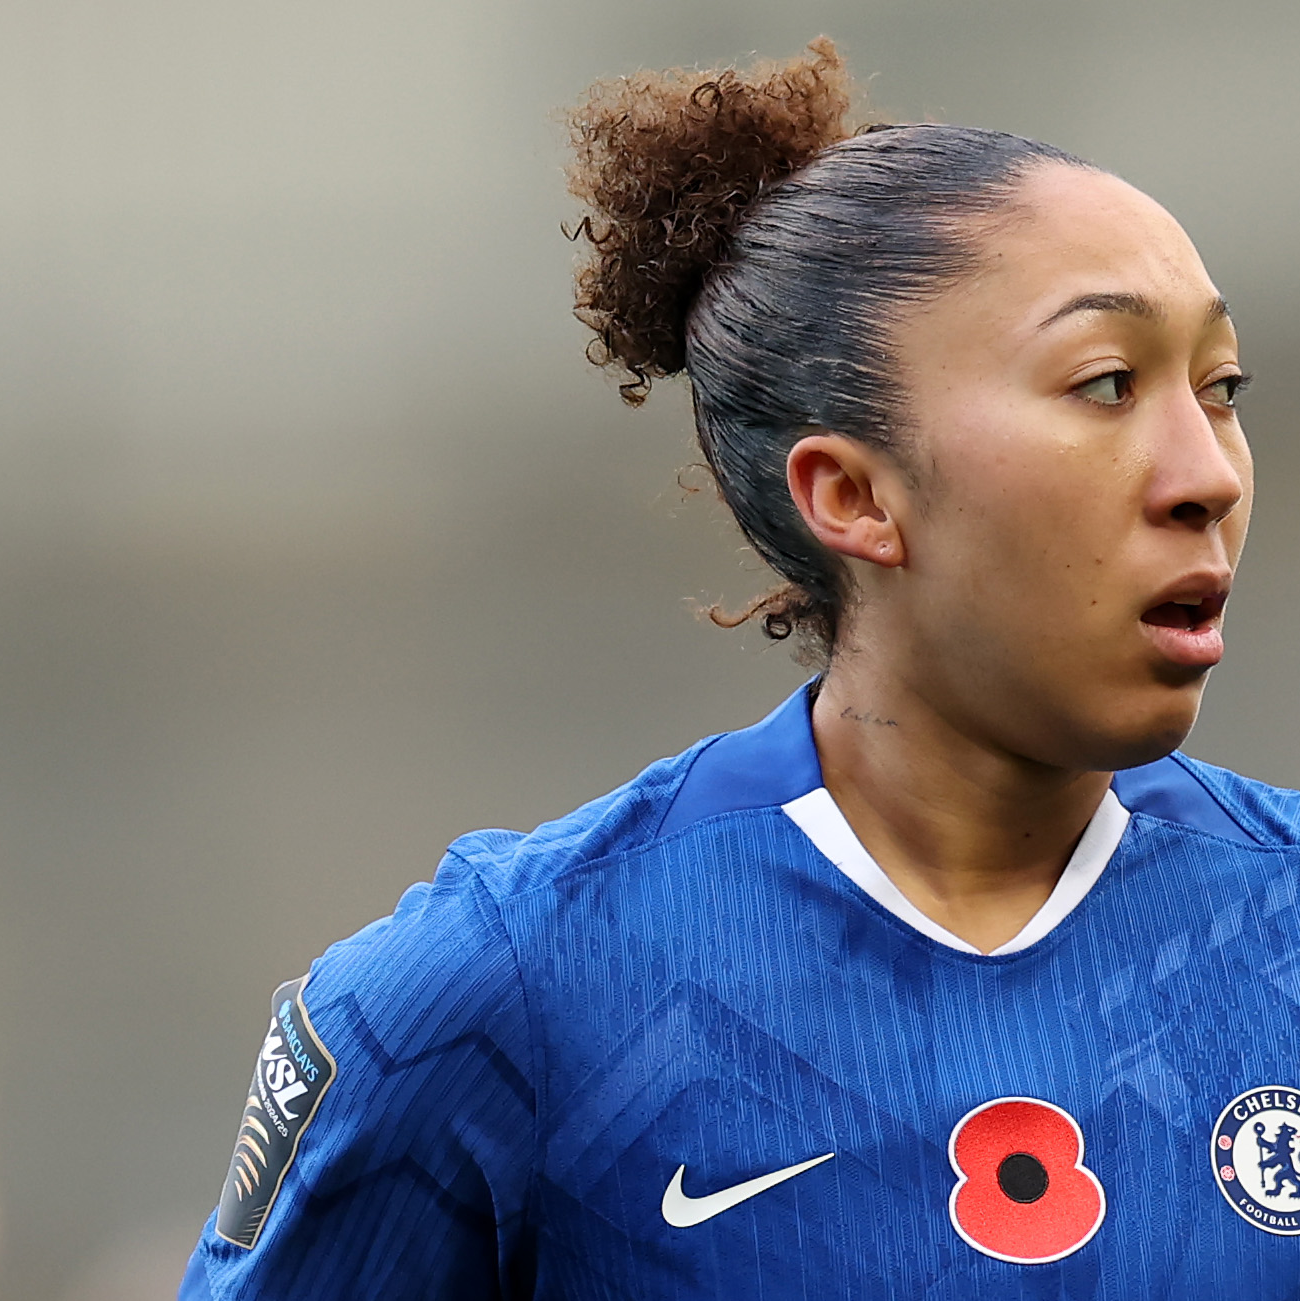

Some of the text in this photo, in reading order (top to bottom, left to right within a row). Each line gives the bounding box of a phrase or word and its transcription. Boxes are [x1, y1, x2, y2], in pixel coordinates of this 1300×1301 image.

[262, 1017, 308, 1120] WSL
[282, 1013, 319, 1082] BARCLAYS
[1239, 1198, 1298, 1226] FOOTBALL
